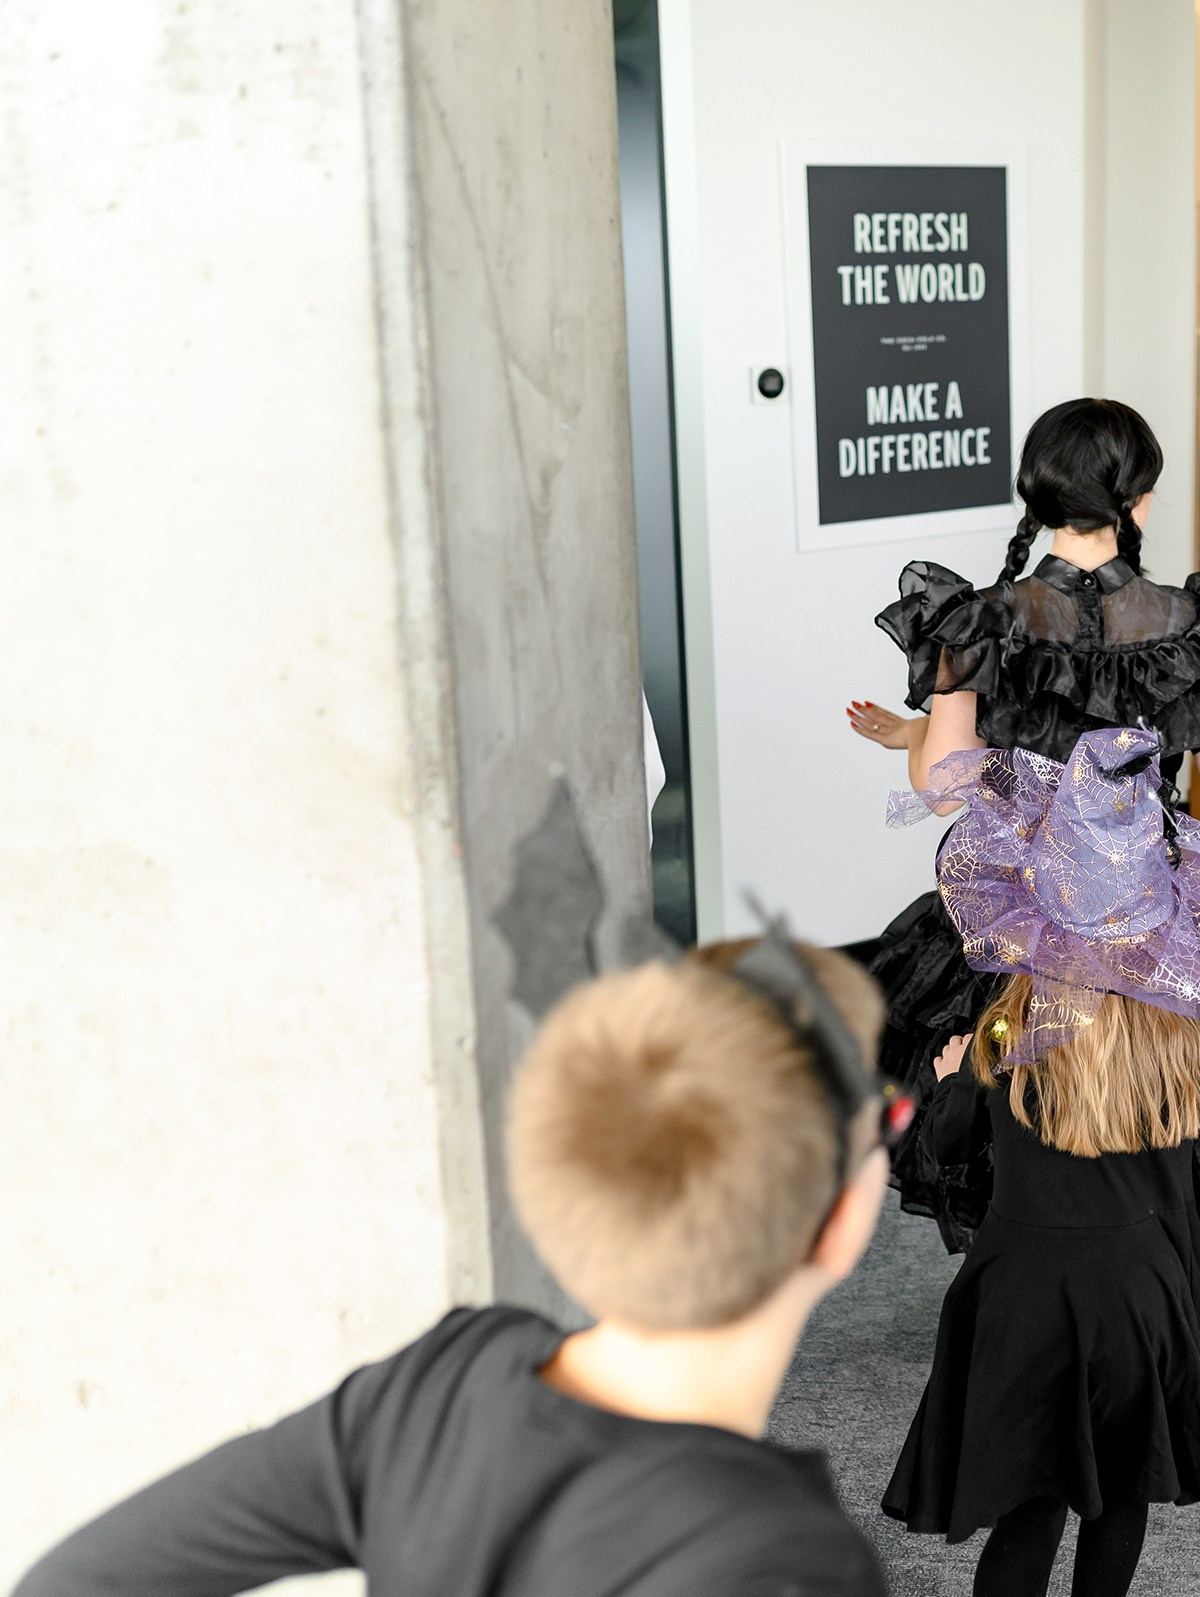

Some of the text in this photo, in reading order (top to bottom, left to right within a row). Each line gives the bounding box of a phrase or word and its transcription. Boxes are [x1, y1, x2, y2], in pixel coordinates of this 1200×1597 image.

[853, 212, 969, 254] REFRESH
[837, 262, 986, 306] THE WORLD
[866, 382, 964, 426] MAKE A
[838, 427, 992, 478] DIFFERENCE
